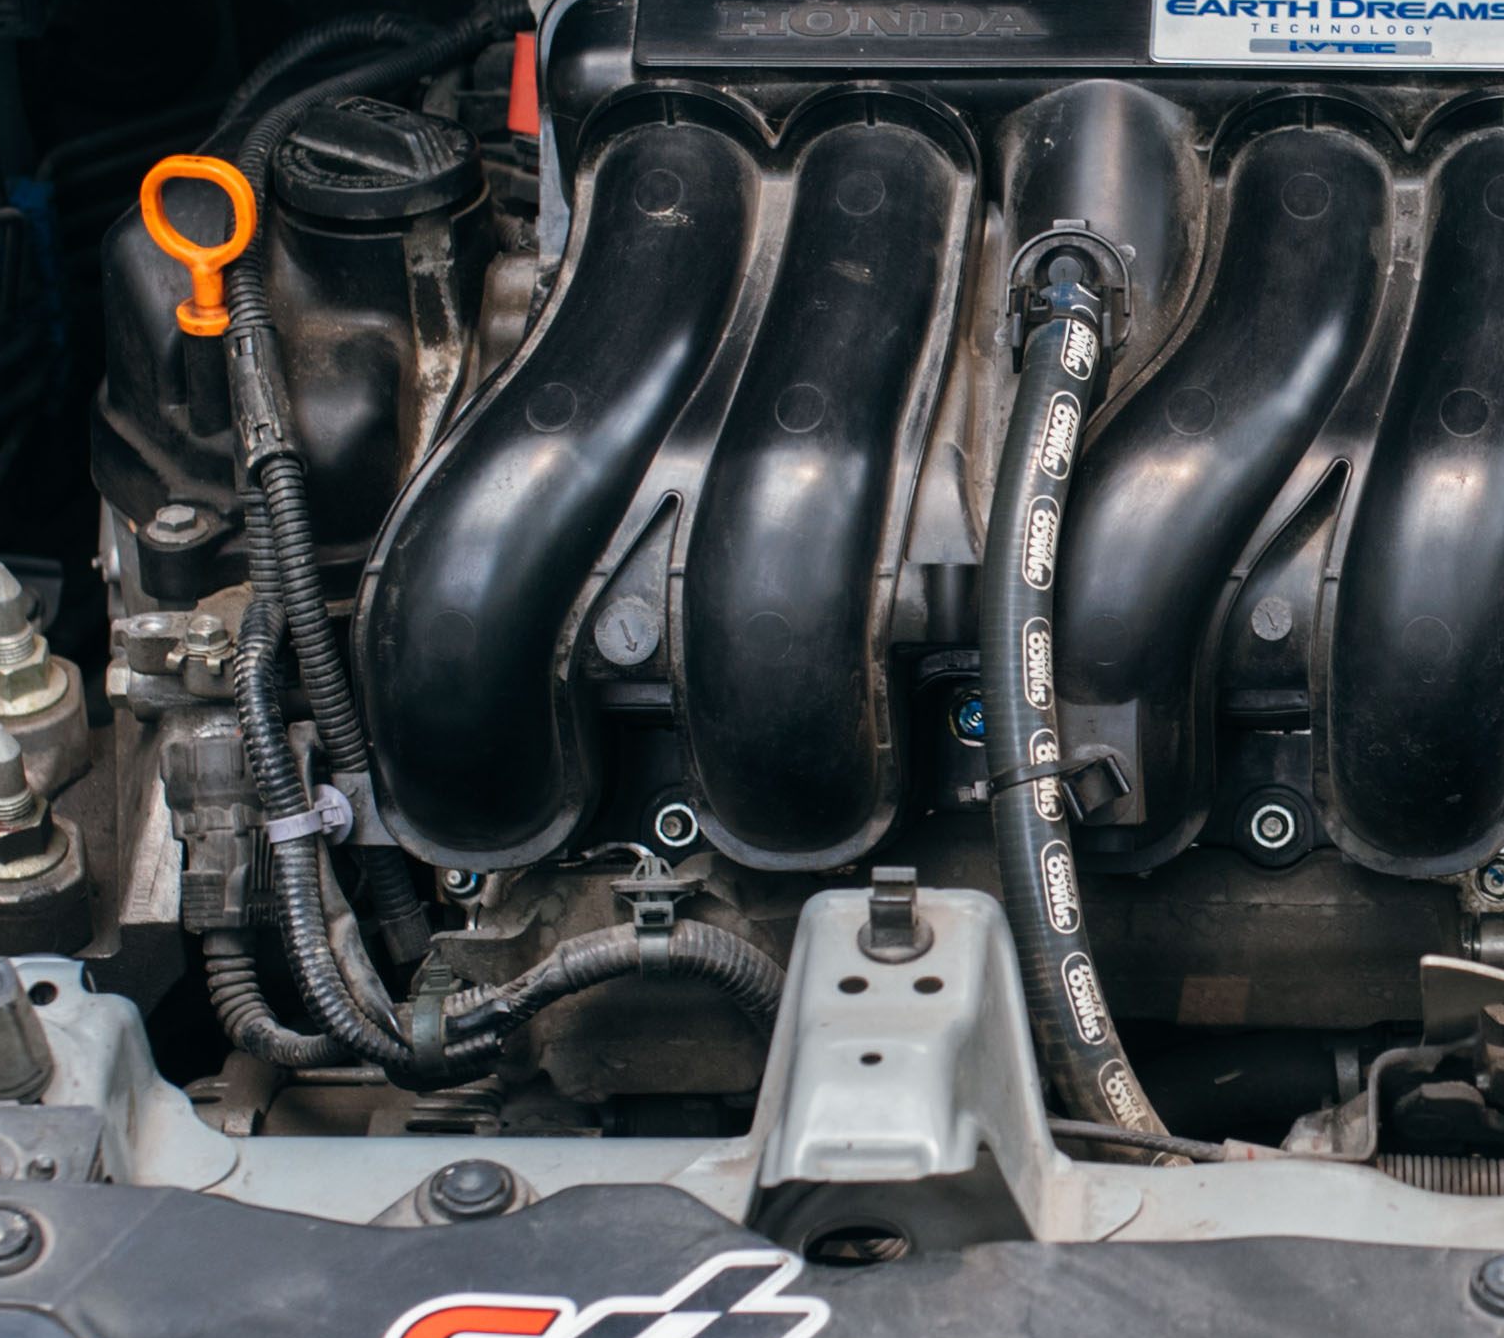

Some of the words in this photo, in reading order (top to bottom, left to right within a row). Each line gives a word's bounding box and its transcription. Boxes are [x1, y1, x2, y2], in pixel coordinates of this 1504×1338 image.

[718, 2, 1045, 39] HONDA
[1252, 22, 1433, 36] TECHNOLOGY
[1042, 403, 1070, 472] SAMCO
[1063, 406, 1079, 461] sport
[1027, 509, 1051, 583] SAMCO
[1045, 515, 1057, 569] sport
[1026, 633, 1047, 705] SAMCO
[1046, 856, 1071, 928] SAMCO
[1060, 854, 1077, 911] sport
[1068, 969, 1100, 1039] SAMCO
[1082, 964, 1102, 1016] sport
